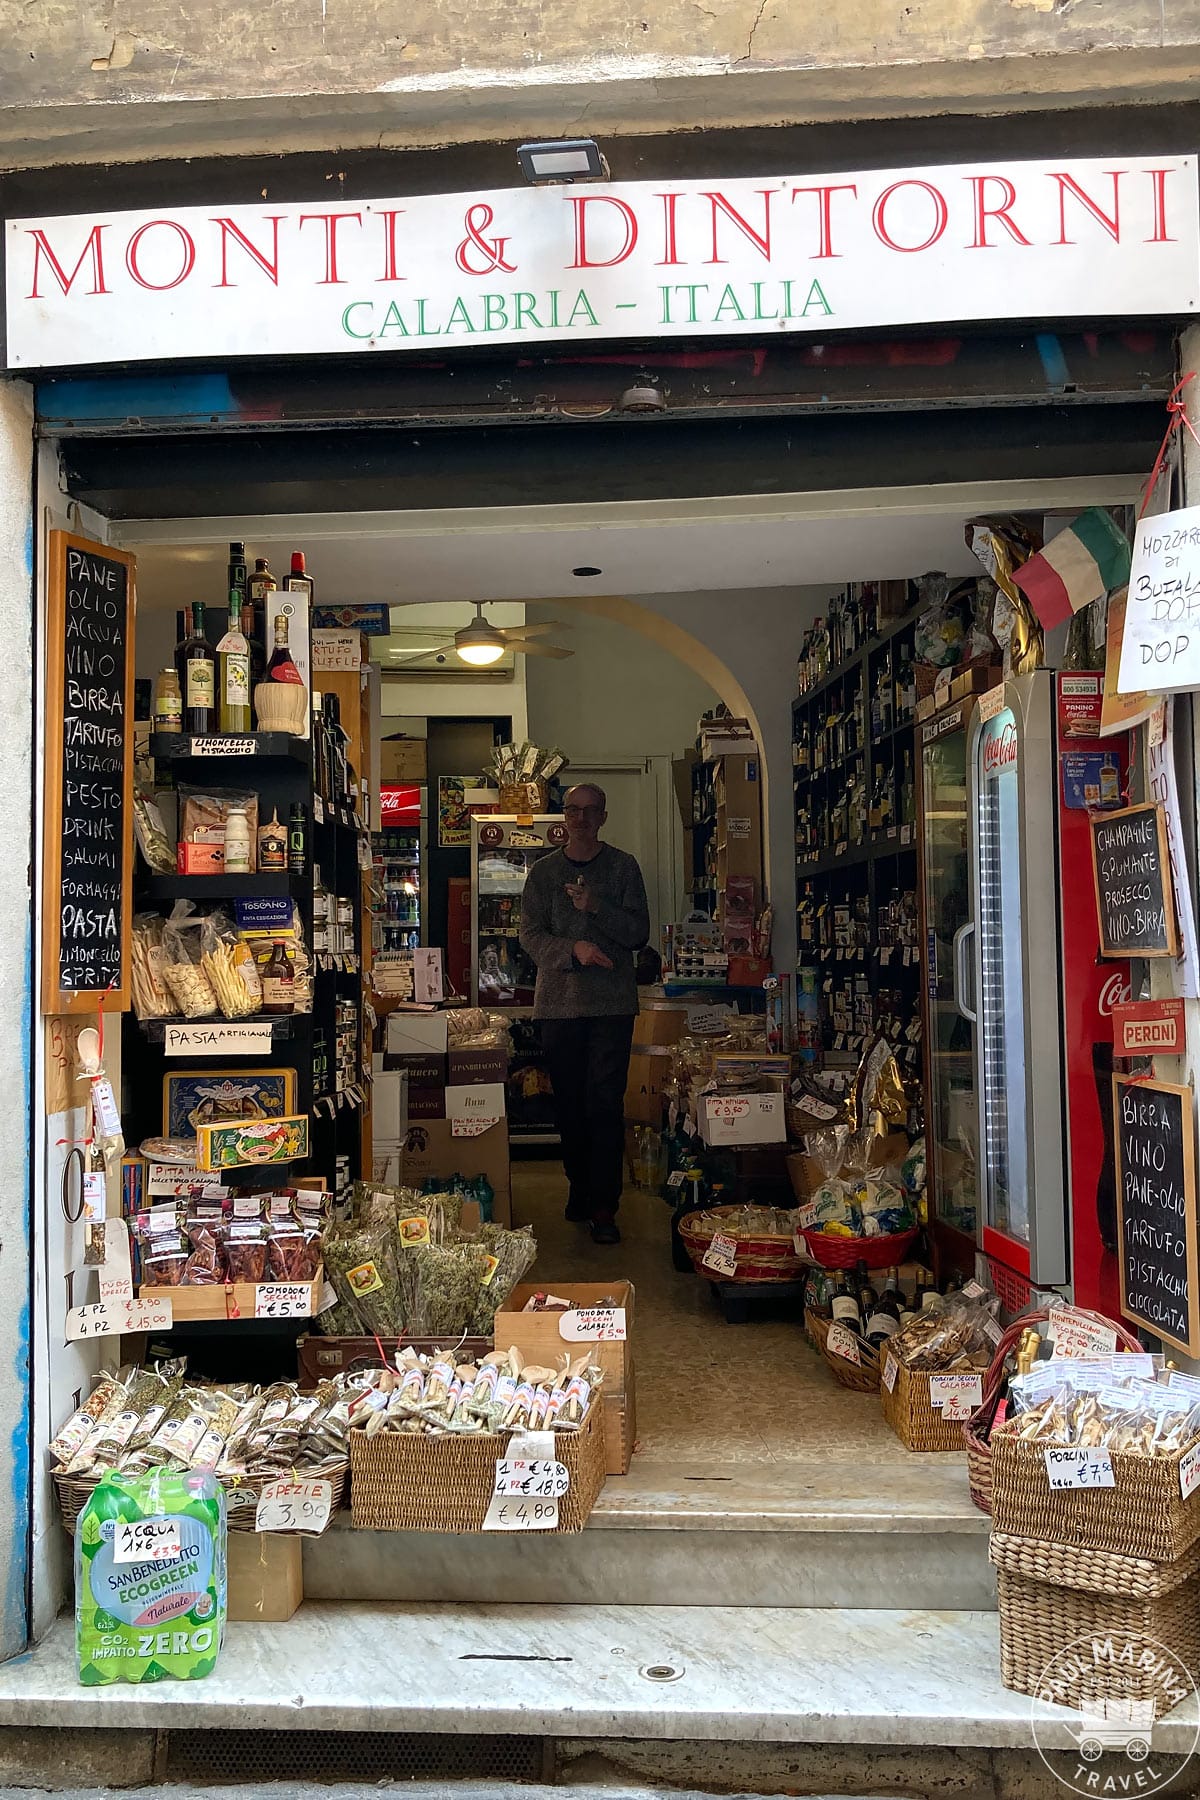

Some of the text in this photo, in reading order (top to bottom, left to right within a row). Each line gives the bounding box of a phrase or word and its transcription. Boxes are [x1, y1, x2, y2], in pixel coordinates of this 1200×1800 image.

[24, 169, 1177, 299] MONTI & DINTORNI
[342, 286, 602, 339] CALABRIA
[657, 278, 835, 324] ITALIA
[68, 551, 117, 592] PANE
[69, 589, 117, 619] OLIO
[67, 616, 122, 645] ACQUA
[67, 645, 115, 677] VINO
[1140, 635, 1190, 665] DOP
[68, 680, 122, 716] BIRRA
[64, 716, 122, 748] TARTUFO
[194, 739, 254, 747] LIMONCELLO
[66, 779, 122, 809] PESTO
[63, 817, 115, 841] DRINK
[1097, 819, 1153, 852] CHAMPAGNE
[64, 848, 115, 869] SALUMI
[1101, 851, 1156, 882] SPUMANTE
[62, 878, 121, 900] FORMAGGI
[1105, 883, 1151, 923] PROSECCO
[62, 904, 117, 938] PASTA
[59, 944, 120, 963] LIMONCELLO
[61, 967, 120, 986] SPRITZ
[169, 1029, 218, 1047] PASTA
[1126, 1023, 1174, 1042] PERONI
[723, 1106, 743, 1117] 9,50
[1122, 1095, 1171, 1131] BIRRA
[1125, 1135, 1166, 1173] VINO
[155, 1166, 185, 1177] PITTA
[1126, 1218, 1185, 1257] TARTUFO
[704, 1253, 712, 1265] €
[258, 1285, 310, 1295] POMODORI
[264, 1294, 302, 1302] SECCHI
[78, 1305, 86, 1317] 1
[92, 1303, 107, 1315] PZ
[124, 1300, 132, 1311] €
[266, 1302, 277, 1316] €
[1128, 1292, 1186, 1335] CIOCCOLATA
[80, 1323, 88, 1335] 4
[95, 1319, 110, 1332] PZ
[125, 1320, 134, 1330] €
[577, 1322, 614, 1331] CALABRIA
[940, 1381, 977, 1389] CALABRIA
[949, 1394, 961, 1408] €
[1049, 1450, 1089, 1463] PORCINI
[499, 1461, 566, 1477] 1 PZ € 4,80
[1077, 1463, 1089, 1483] €
[265, 1483, 323, 1499] SPEZIE
[496, 1477, 568, 1496] 4 PZ € 18,00
[257, 1501, 327, 1527] € 3,90
[498, 1503, 555, 1527] € 4,80
[121, 1524, 175, 1539] ACQUA
[119, 1561, 199, 1604] ECOGREEN
[147, 1596, 190, 1620] Naturale
[92, 1646, 136, 1660] IMPATTO
[138, 1627, 213, 1657] ZERO
